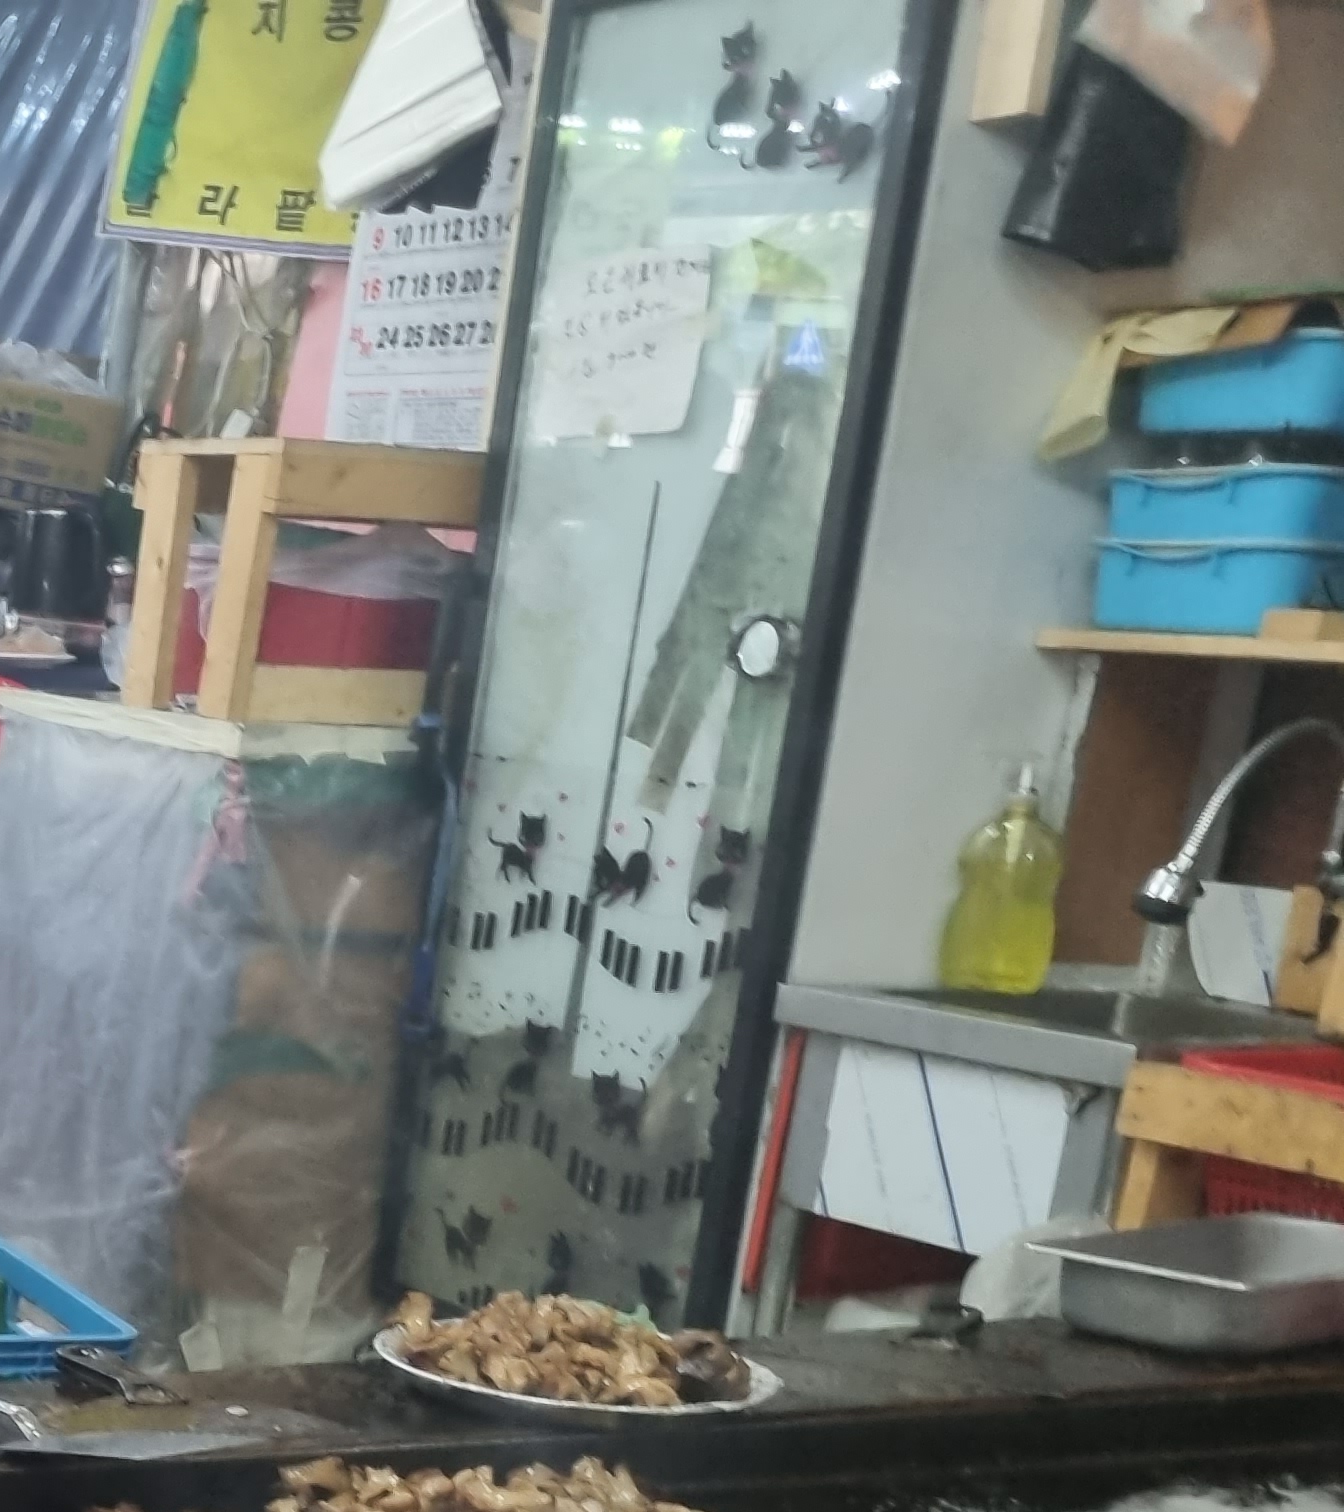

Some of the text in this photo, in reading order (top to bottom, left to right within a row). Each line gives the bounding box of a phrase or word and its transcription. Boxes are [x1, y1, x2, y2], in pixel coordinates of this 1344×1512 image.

[372, 227, 385, 250] 9
[394, 224, 414, 248] 10
[419, 221, 438, 246] 11
[443, 217, 465, 243] 12
[469, 214, 490, 240] 13
[362, 278, 383, 301] 16
[387, 273, 407, 299] 17
[413, 271, 431, 298] 18
[435, 270, 458, 296] 19
[461, 268, 485, 293] 20
[375, 326, 400, 349] 24
[404, 325, 425, 348] 25
[428, 322, 451, 348] 26
[454, 320, 478, 346] 27
